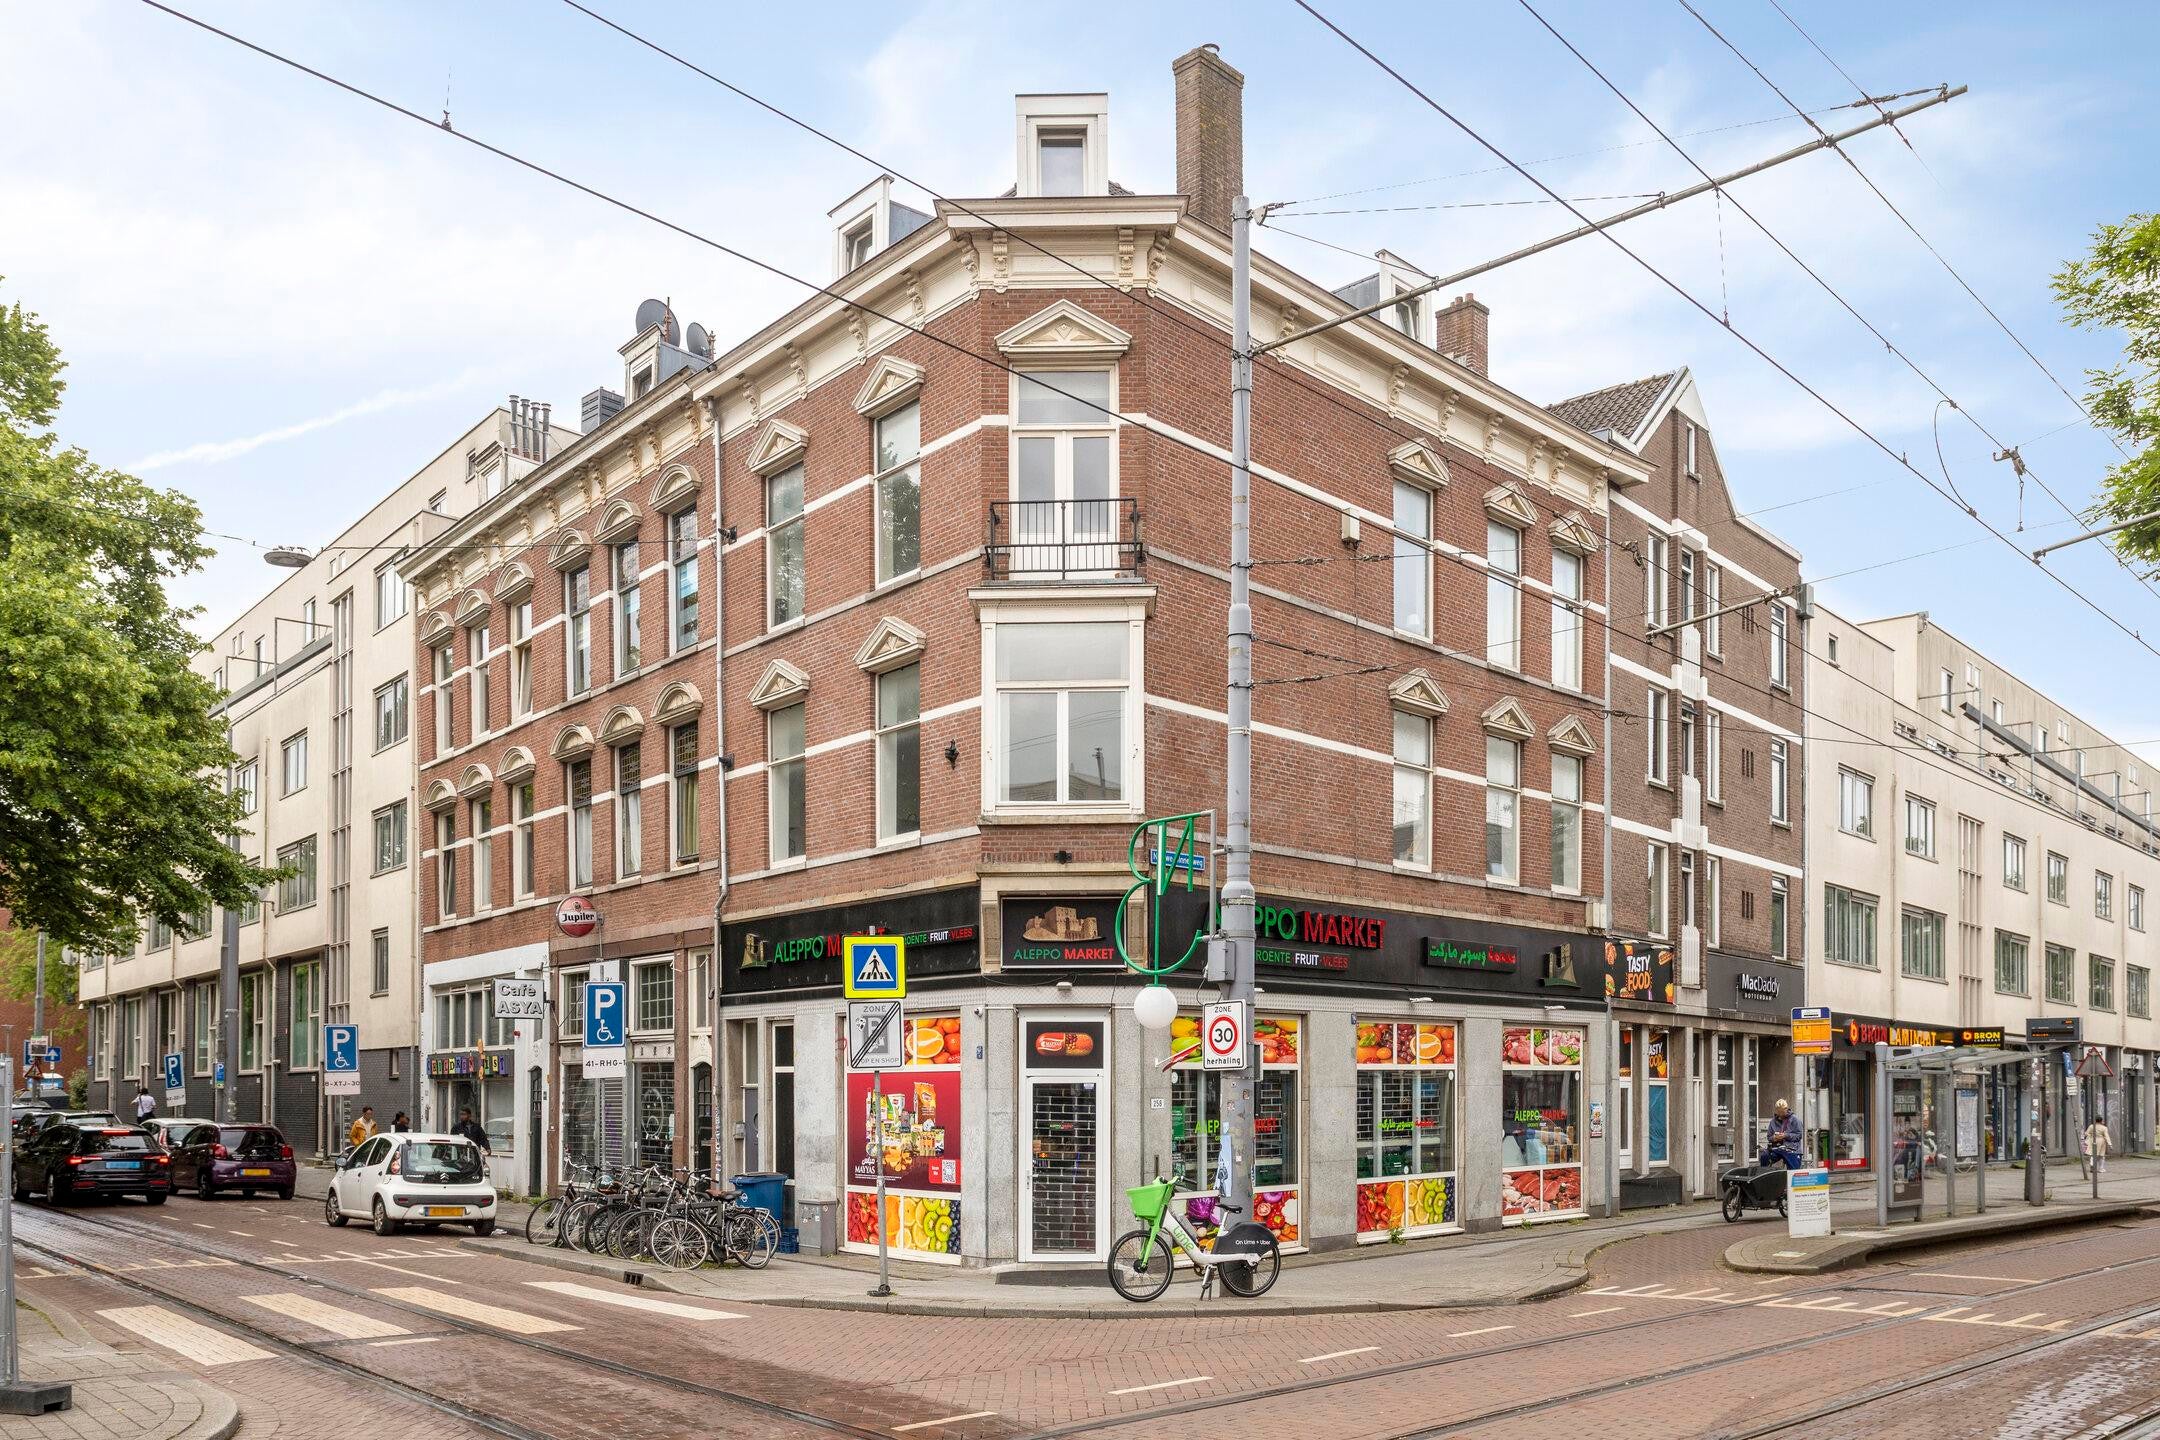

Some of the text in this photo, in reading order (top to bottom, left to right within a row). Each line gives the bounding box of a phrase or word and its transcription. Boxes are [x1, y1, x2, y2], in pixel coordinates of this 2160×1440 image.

[562, 911, 595, 923] Jupiler
[930, 930, 948, 942] FRUIT
[951, 928, 973, 941] VLEES
[1303, 910, 1387, 949] MARKET
[773, 936, 823, 963] ALEPPO
[1013, 948, 1114, 960] ALEPPO MARKET
[1256, 950, 1349, 969] ROENTE FRUIT VLEES
[1627, 954, 1650, 973] TASTY
[1628, 971, 1650, 991] FOOD
[1741, 973, 1780, 997] MacDaddy
[500, 983, 536, 997] Café
[1744, 993, 1773, 1001] ROTTERDAM
[497, 1001, 542, 1014] ASYA
[594, 988, 616, 1020] P
[863, 1005, 887, 1013] ZONE
[332, 1029, 350, 1052] P
[1214, 1028, 1234, 1042] 30
[1861, 1024, 1888, 1044] BRON
[1889, 1027, 1937, 1046] LAMINAAT
[168, 1057, 178, 1074] P
[1206, 1057, 1241, 1066] herhaling
[1515, 1109, 1540, 1121] ALEPPO
[855, 1165, 875, 1174] MAYYAS
